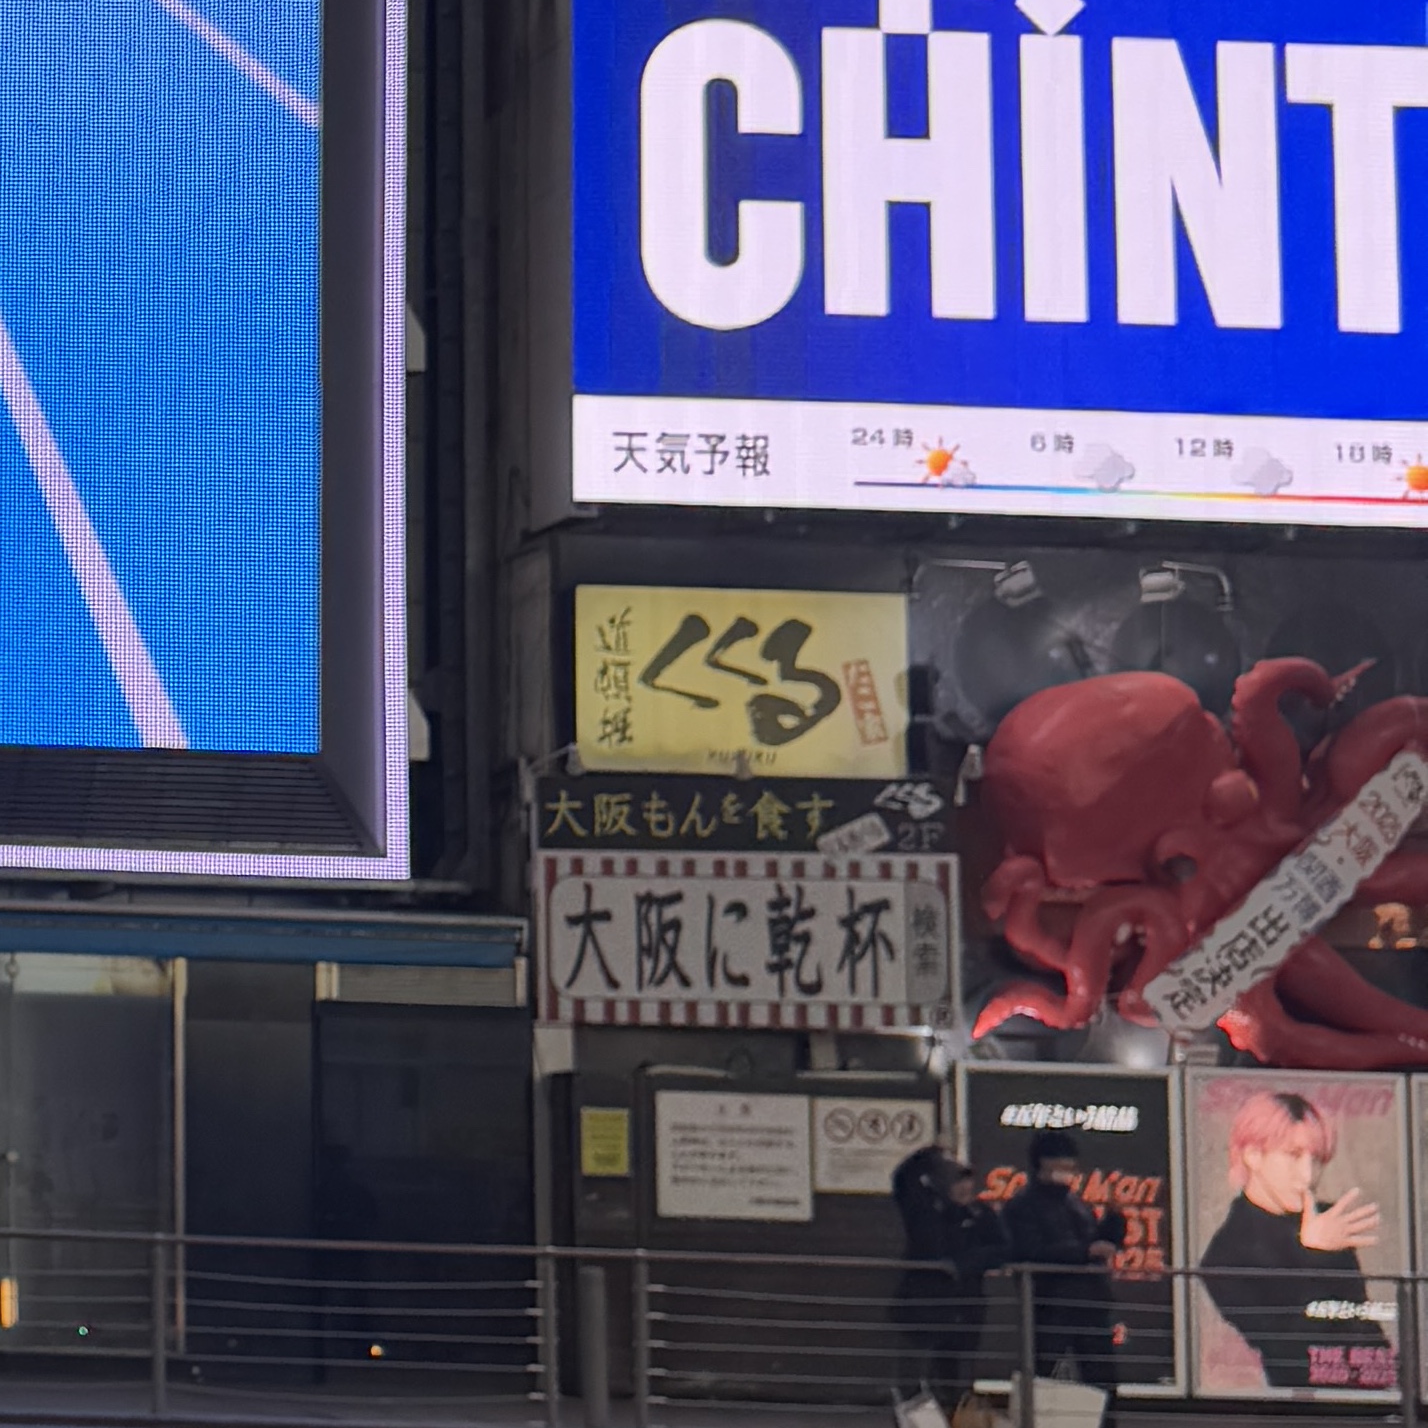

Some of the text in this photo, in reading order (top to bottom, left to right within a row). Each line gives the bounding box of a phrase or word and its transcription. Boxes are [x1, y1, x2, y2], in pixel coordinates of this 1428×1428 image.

[612, 431, 770, 477] 天気予報
[638, 613, 842, 746] くくる
[545, 789, 835, 840] 大阪もんを食す
[897, 821, 945, 850] 2F
[564, 883, 896, 998] 大阪に乾杯
